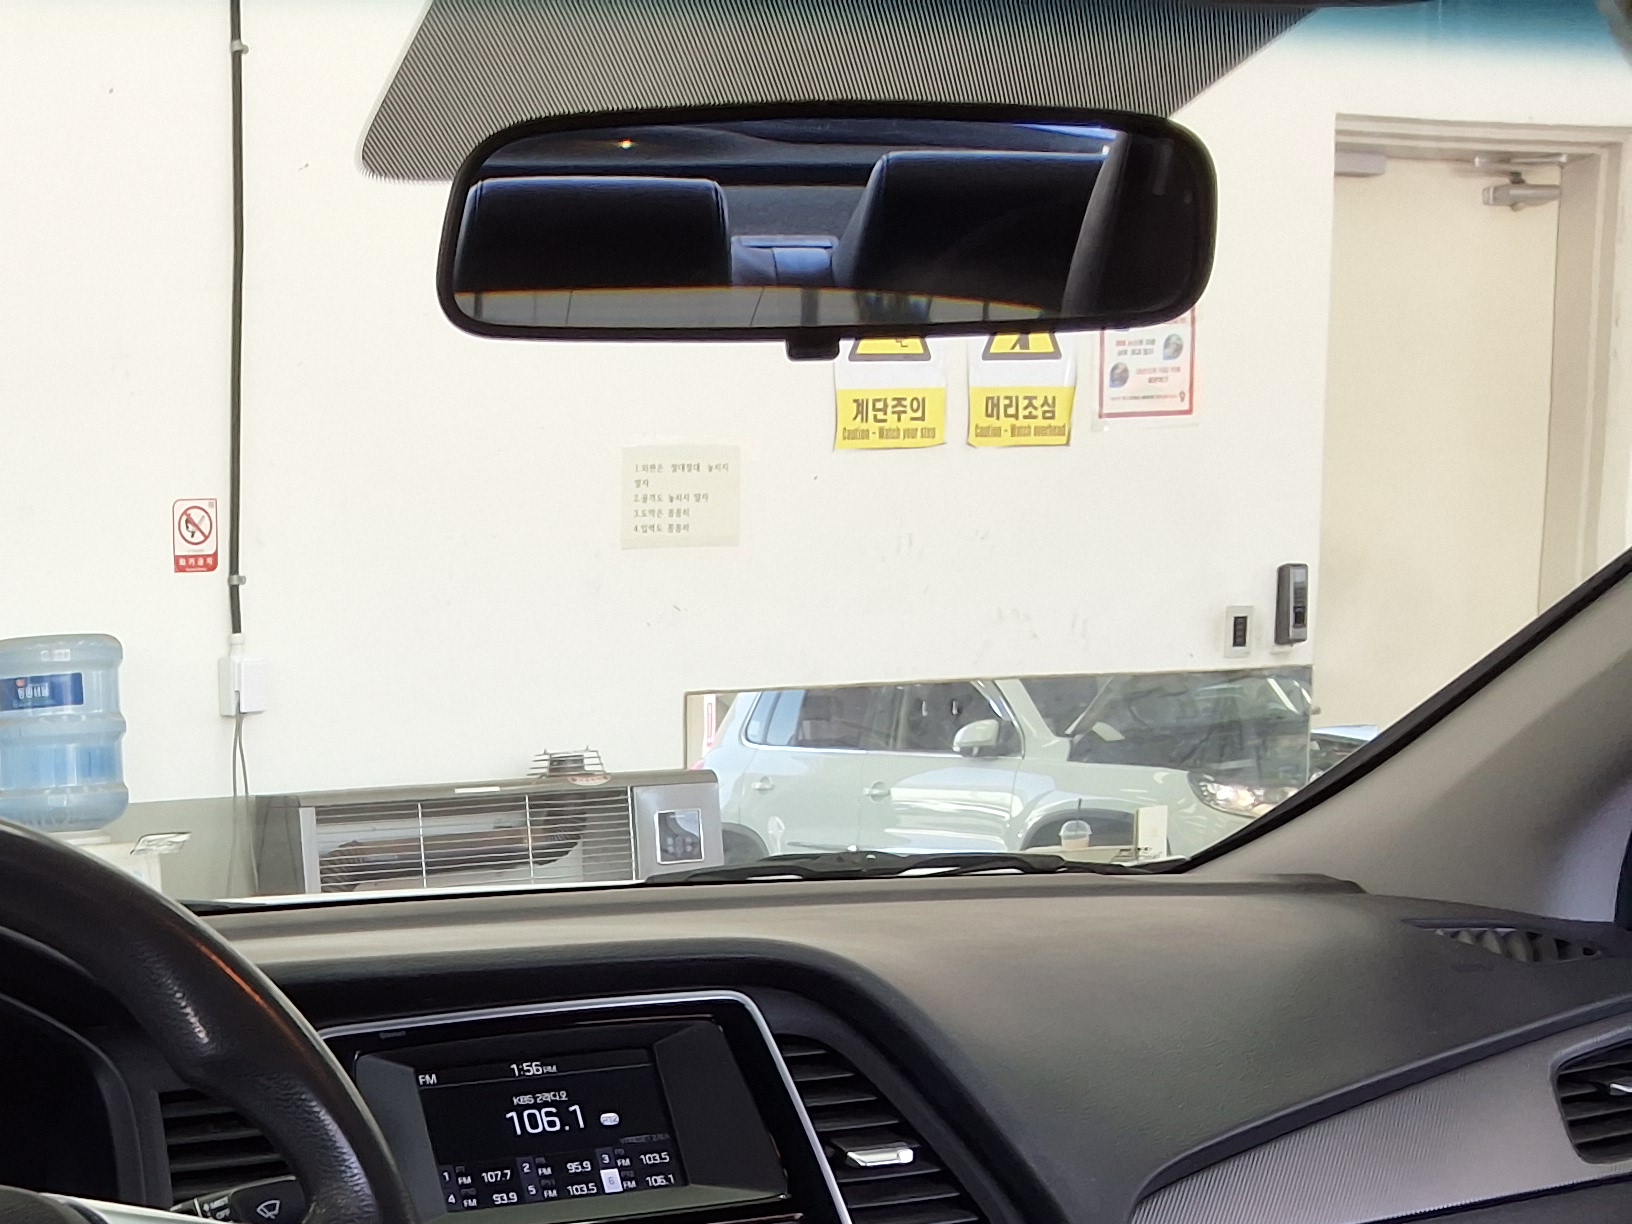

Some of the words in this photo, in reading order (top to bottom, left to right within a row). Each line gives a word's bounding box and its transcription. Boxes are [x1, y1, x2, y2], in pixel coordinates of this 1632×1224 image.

[852, 396, 926, 424] 계단주의
[985, 395, 1056, 421] 머리조심
[418, 1073, 438, 1085] FM
[505, 1104, 585, 1136] 106.1
[602, 1154, 610, 1163] 3
[639, 1152, 670, 1165] 103.5
[522, 1163, 531, 1173] 2
[566, 1161, 592, 1174] 95.9
[443, 1172, 450, 1182] 1
[481, 1170, 511, 1183] 107.7
[528, 1185, 536, 1195] 5
[566, 1183, 597, 1195] 103.5
[448, 1194, 456, 1204] 4
[492, 1192, 518, 1204] 93.9
